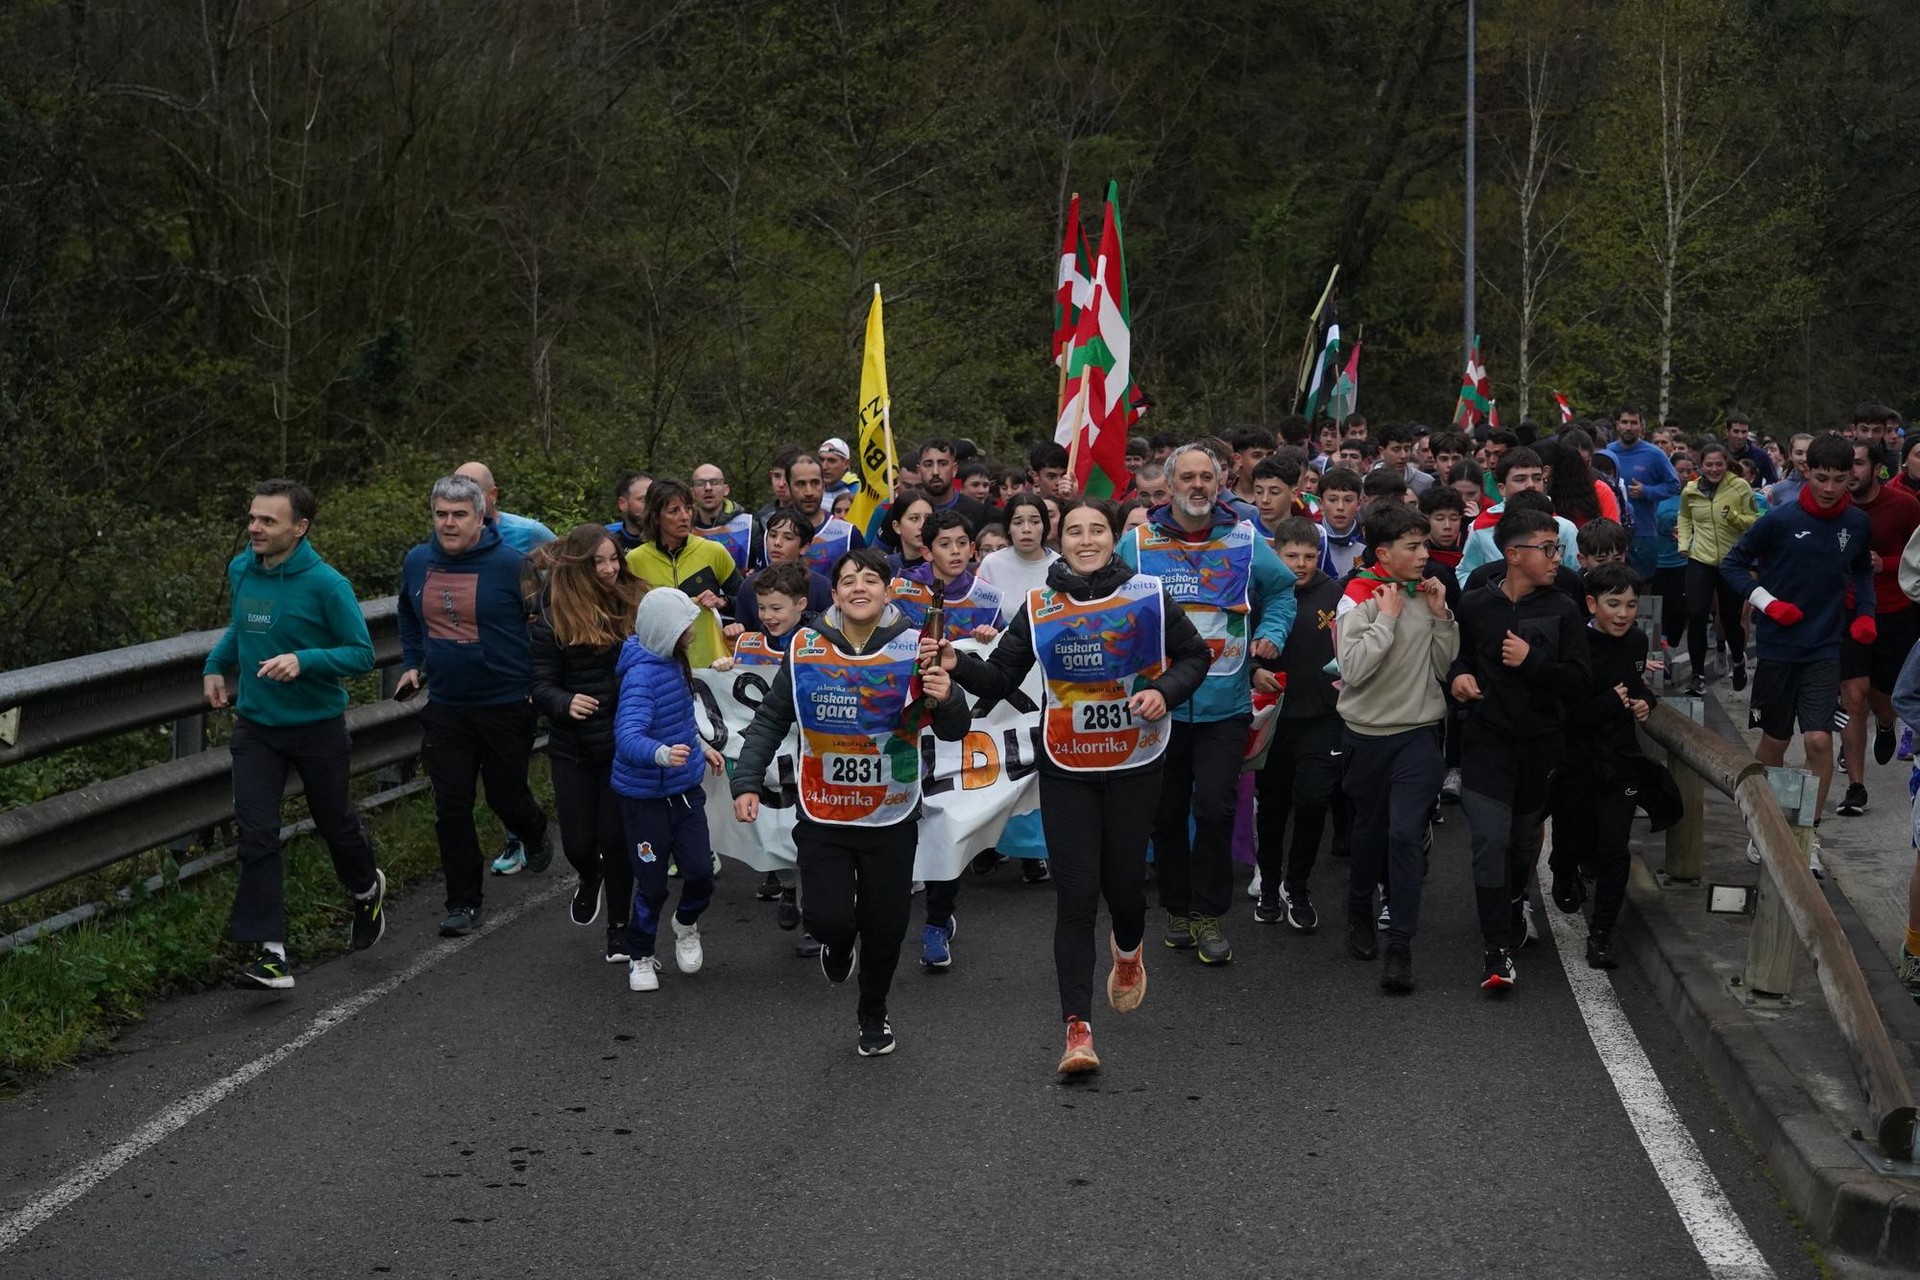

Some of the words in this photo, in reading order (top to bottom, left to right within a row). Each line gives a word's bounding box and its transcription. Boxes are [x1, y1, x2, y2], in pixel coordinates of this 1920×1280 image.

[1231, 531, 1252, 540] eitb
[1133, 581, 1157, 591] eitb
[1160, 573, 1199, 584] Euskara
[1166, 583, 1199, 596] gara
[981, 592, 999, 604] eitb
[1054, 641, 1101, 654] Euskara
[1223, 643, 1241, 657] aek
[1062, 653, 1103, 671] gara
[811, 692, 857, 705] Euskara
[816, 704, 857, 721] gara
[1083, 701, 1132, 730] 2831
[1054, 737, 1128, 755] 24.korrika
[1138, 729, 1161, 748] aek
[832, 757, 882, 783] 2831
[806, 788, 874, 807] 24.korrika
[882, 790, 911, 806] aek
